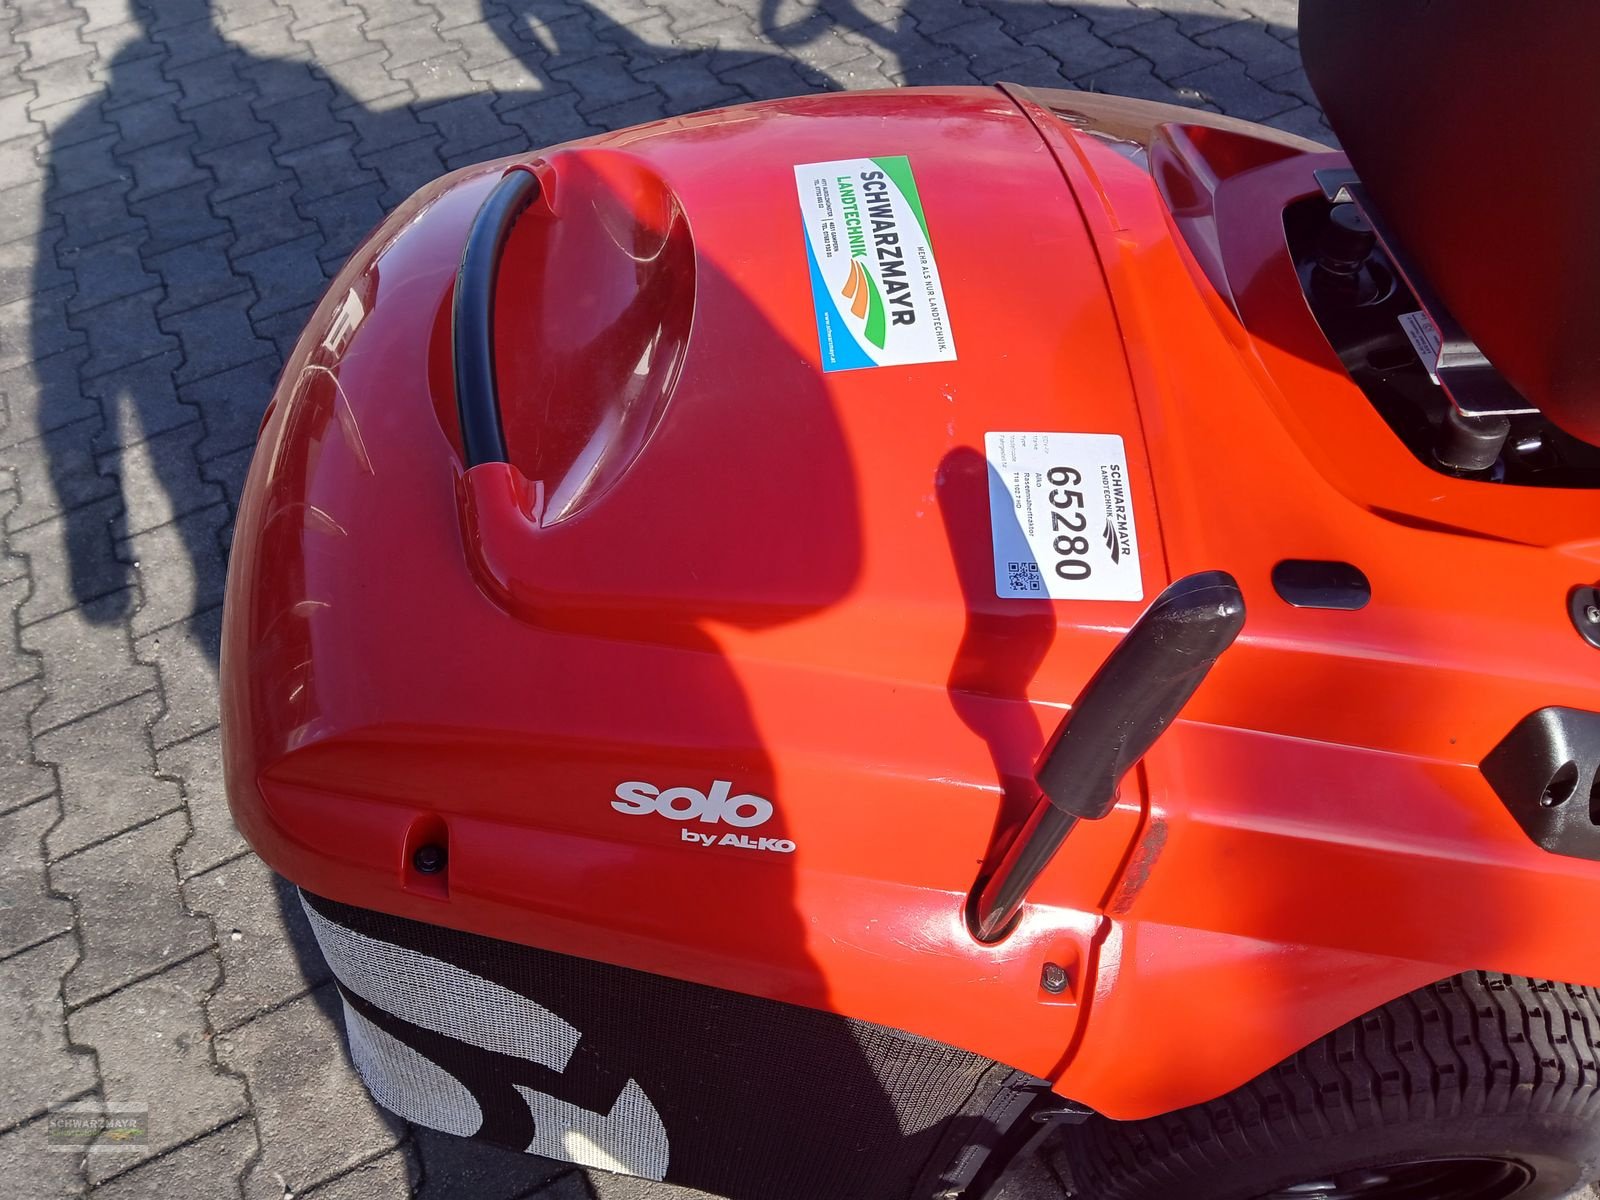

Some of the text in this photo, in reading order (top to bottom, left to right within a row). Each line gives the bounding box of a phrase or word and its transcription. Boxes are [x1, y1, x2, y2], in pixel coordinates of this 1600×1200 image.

[836, 176, 868, 259] LANDTECHNIK
[859, 171, 916, 326] SCHWARZMAYR
[915, 246, 947, 353] MEHR ALS NUR LANDTECHNIK.
[1046, 466, 1092, 581] 65280
[1100, 465, 1113, 518] LANDTECHNIK
[1109, 464, 1131, 556] SCHWARZMAYR
[610, 780, 774, 828] solo
[681, 828, 796, 853] by AL-KO
